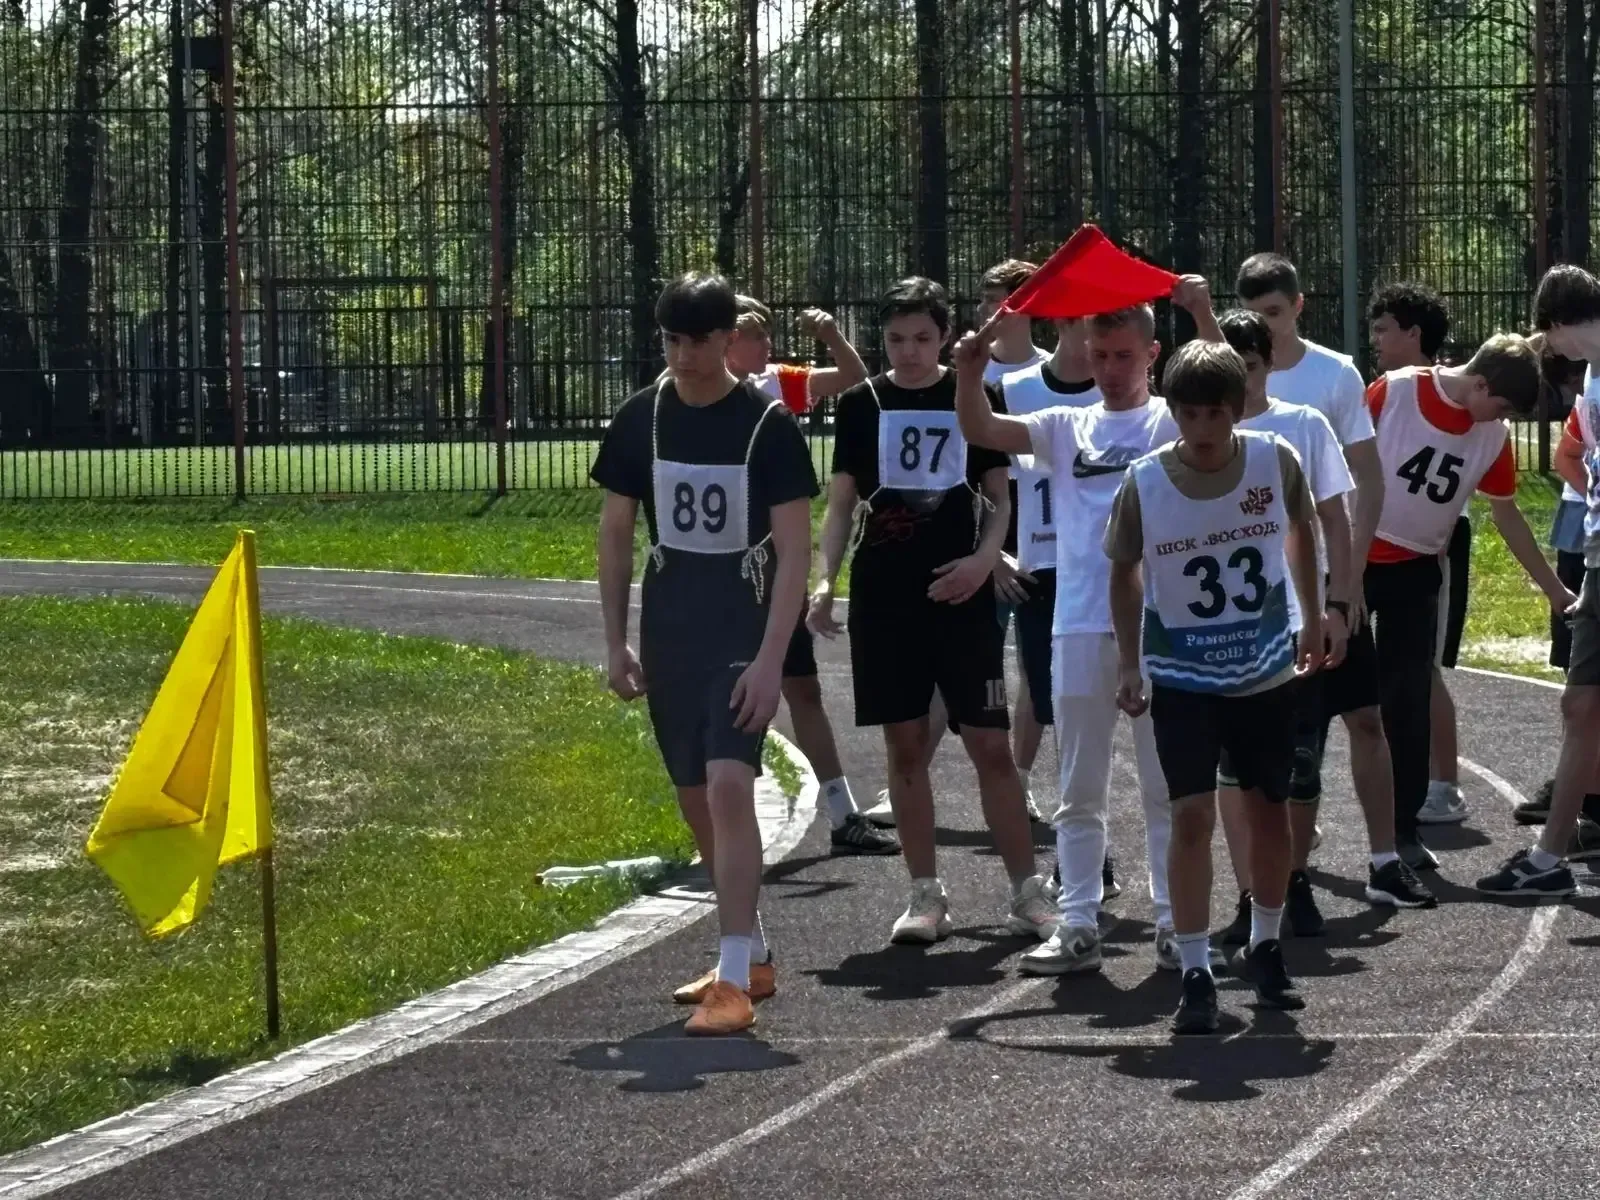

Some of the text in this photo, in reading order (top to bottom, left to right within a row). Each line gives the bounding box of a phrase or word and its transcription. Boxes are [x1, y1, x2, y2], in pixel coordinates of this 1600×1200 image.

[900, 426, 950, 473] 87
[1396, 445, 1465, 504] 45
[673, 482, 727, 534] 89
[1182, 546, 1268, 618] 33
